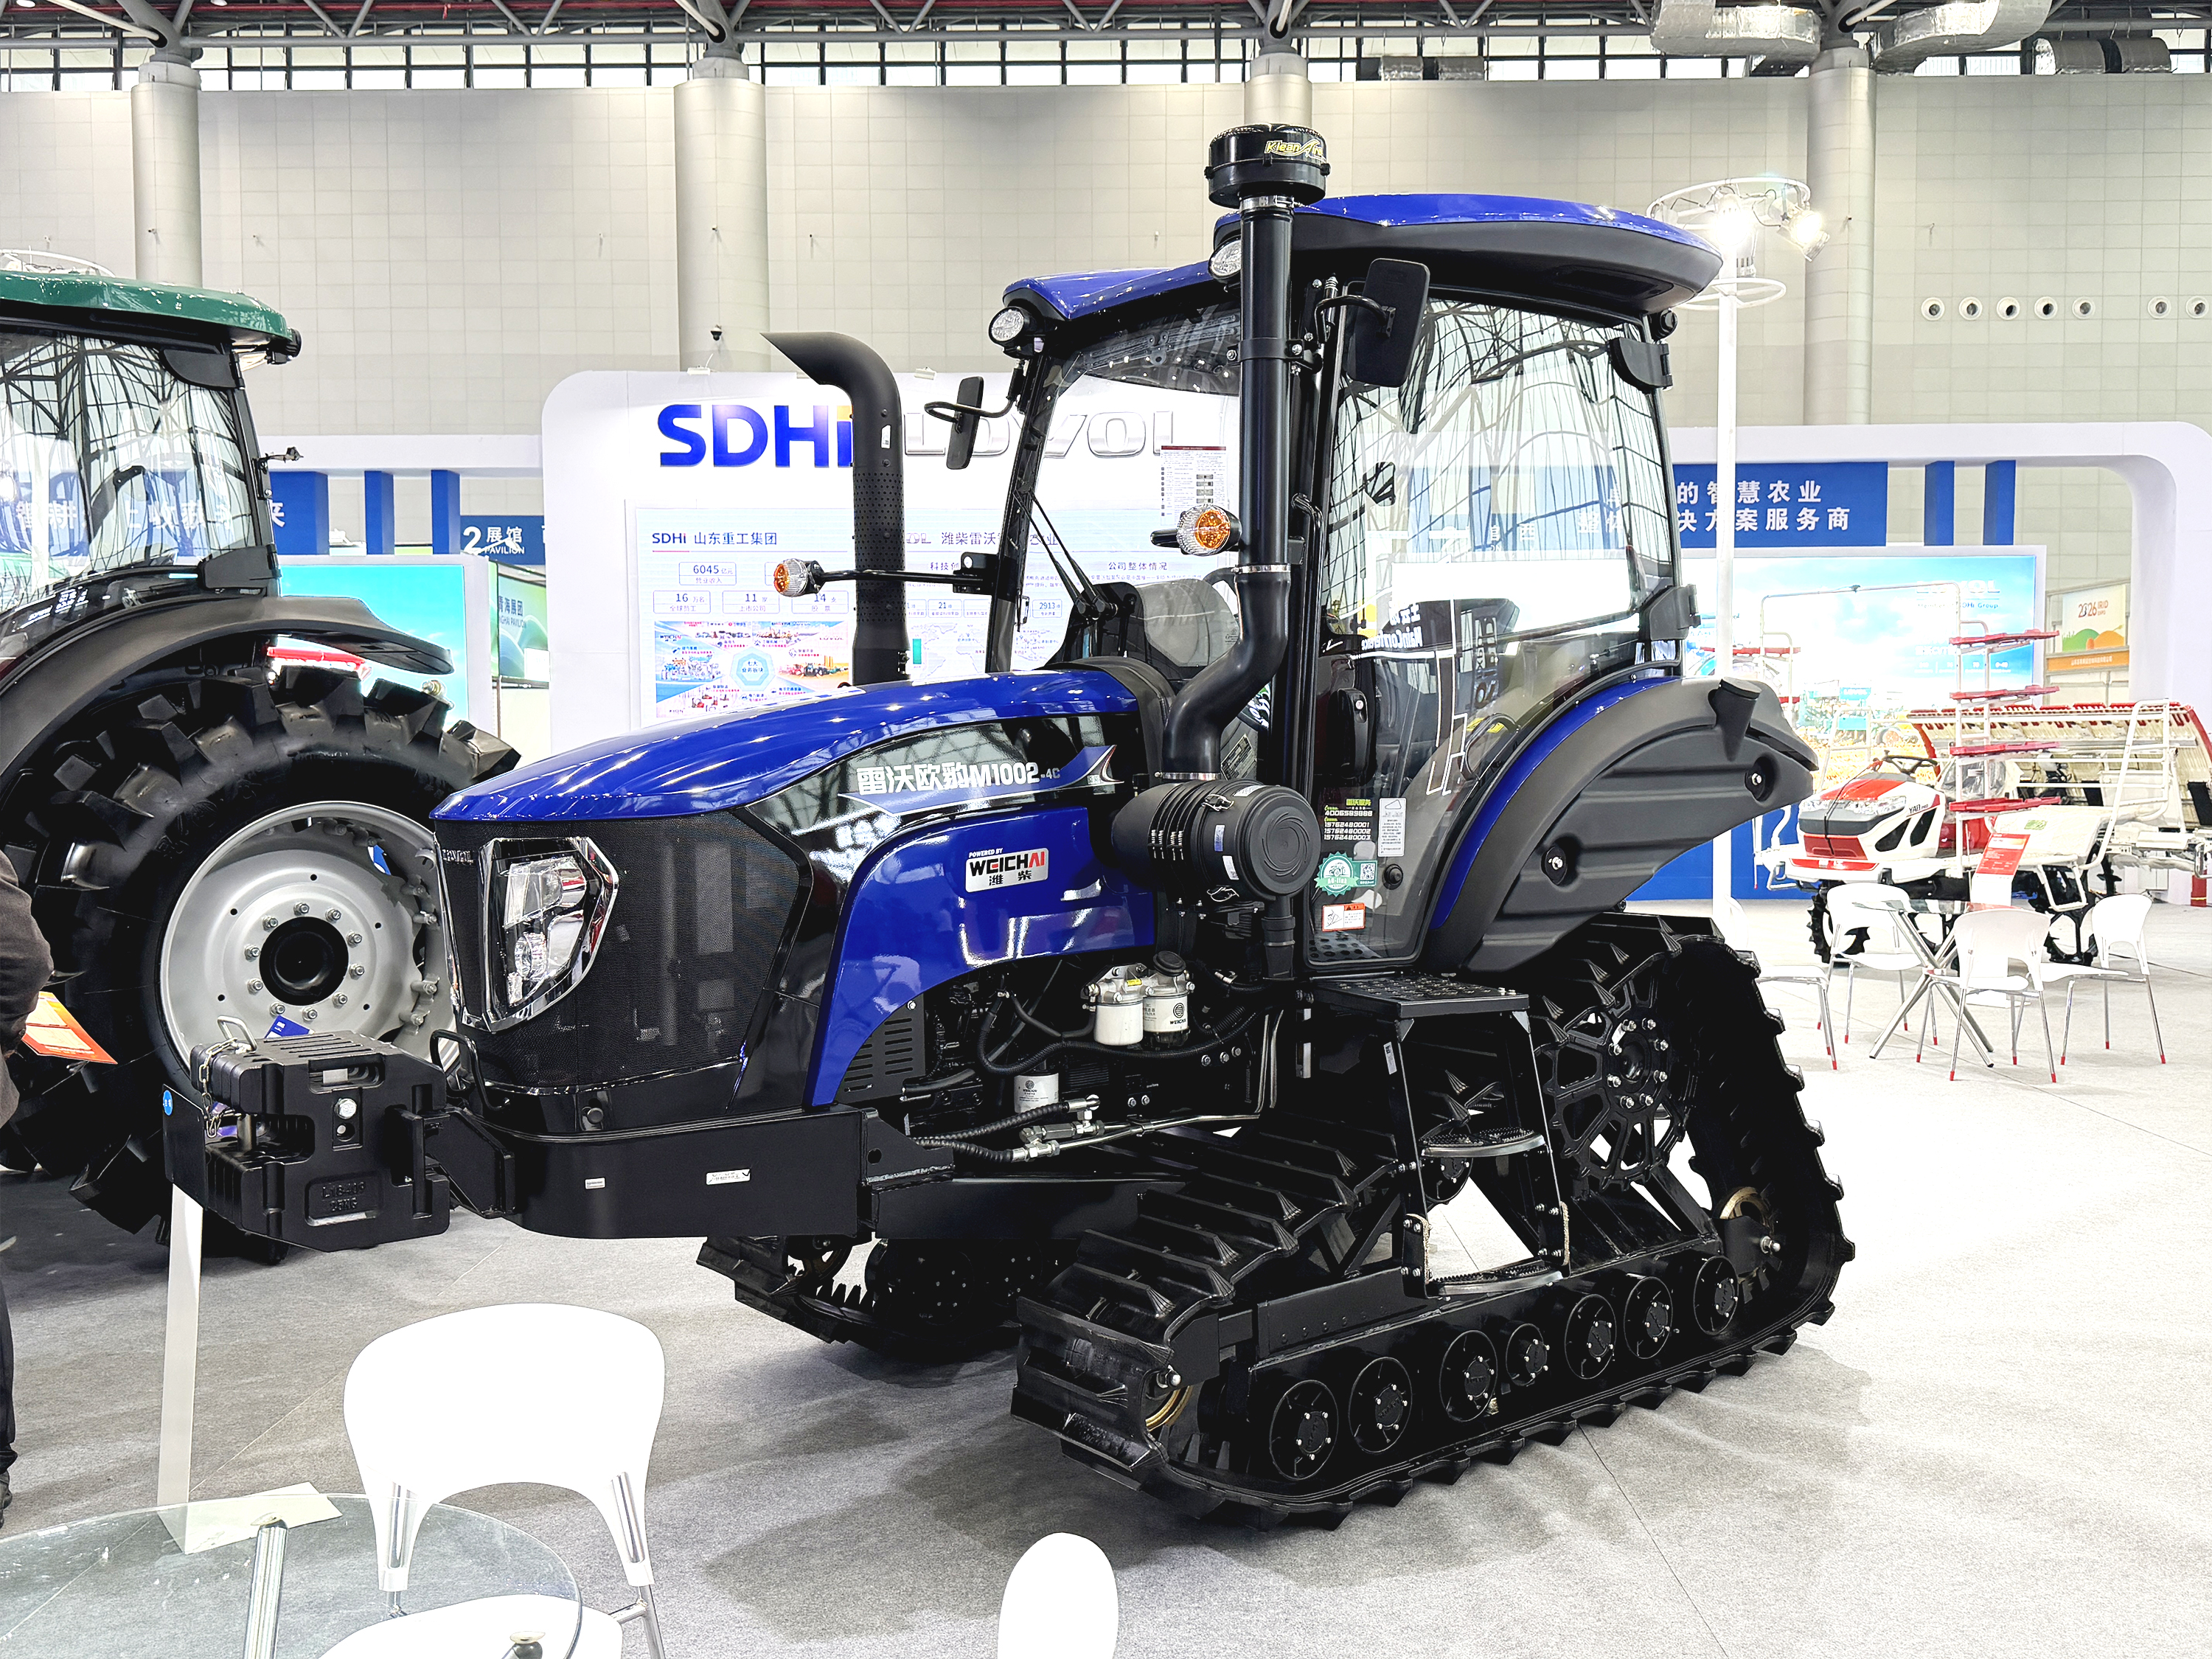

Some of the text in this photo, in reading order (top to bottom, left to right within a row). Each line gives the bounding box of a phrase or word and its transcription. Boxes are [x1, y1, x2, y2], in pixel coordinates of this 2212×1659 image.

[658, 404, 852, 468] SDHi
[463, 526, 482, 553] 2
[652, 532, 777, 546] SDHi 山东重工集团
[693, 565, 719, 574] 6045
[1108, 562, 1168, 571] 公司整体情况
[676, 594, 689, 602] 16
[745, 594, 757, 602] 11
[969, 849, 995, 858] POWERED
[970, 851, 1045, 877] WEICHAI
